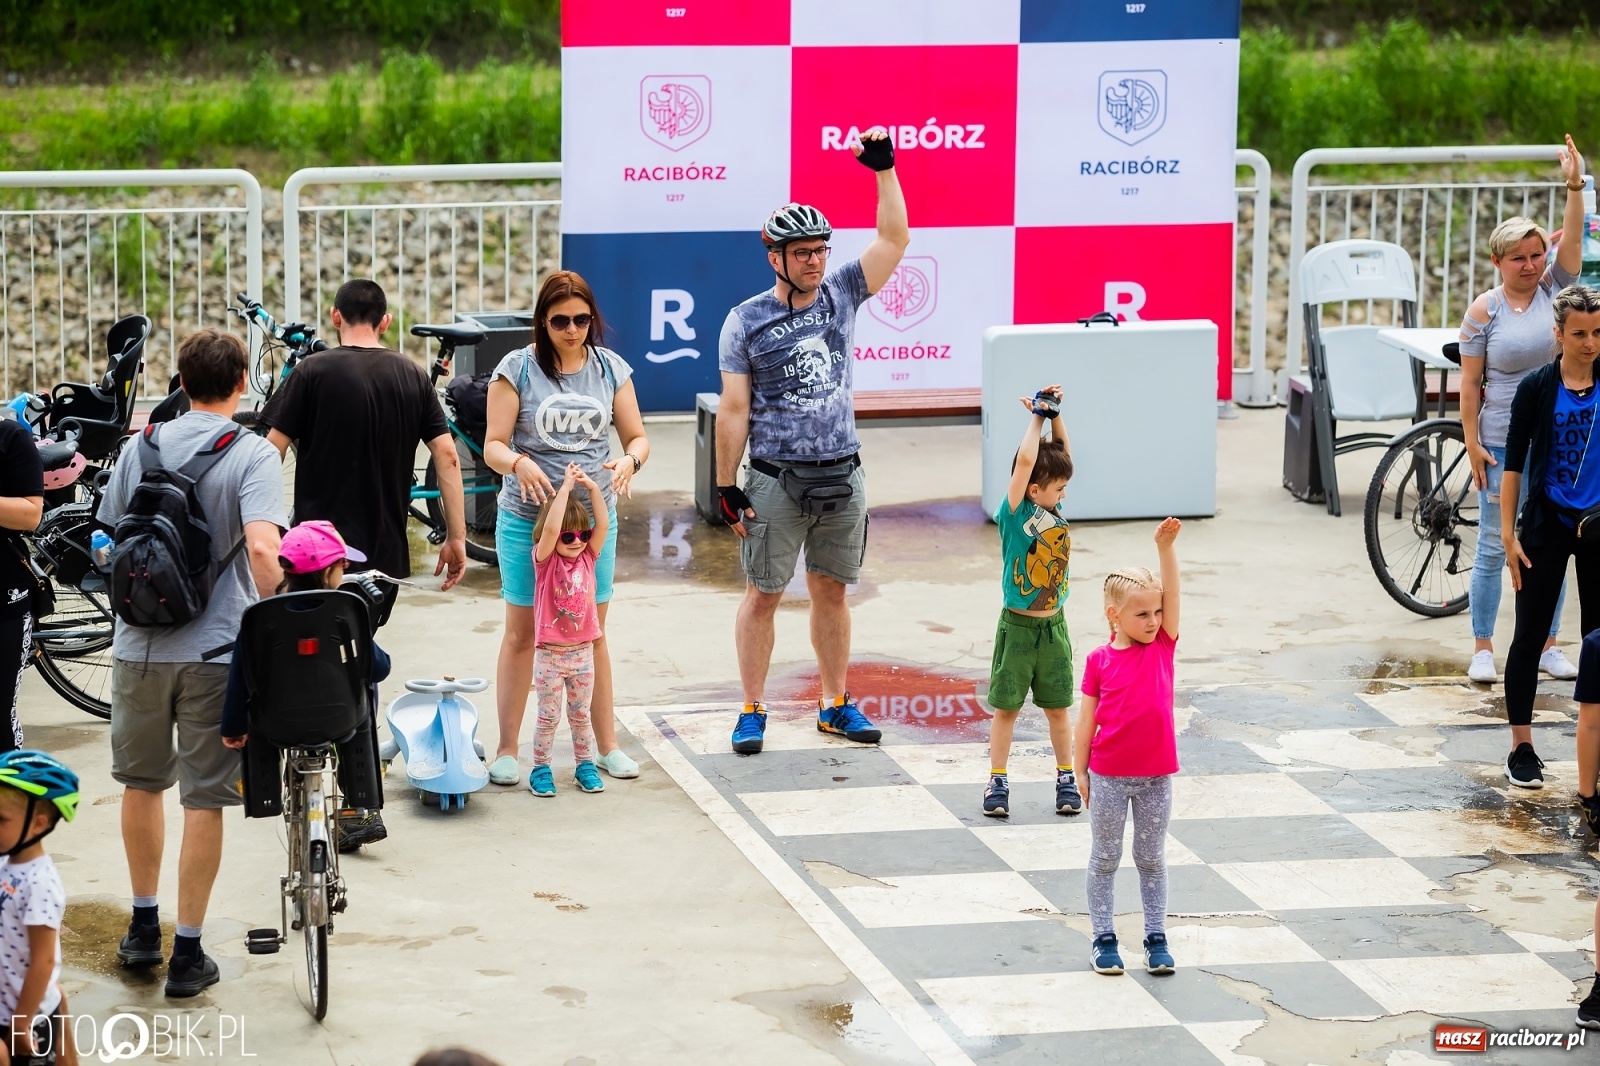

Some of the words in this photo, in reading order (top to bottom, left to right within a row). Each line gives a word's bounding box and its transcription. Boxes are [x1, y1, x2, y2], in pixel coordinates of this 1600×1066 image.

[666, 8, 686, 18] 1217
[1126, 3, 1146, 13] 1217
[822, 117, 986, 151] RAIBÓRZ
[624, 161, 727, 181] RACIBÓRZ
[1080, 155, 1180, 175] RACIBÓRZ
[666, 194, 685, 202] 1217
[1121, 187, 1139, 195] 1217
[650, 288, 697, 341] R
[770, 312, 834, 340] DIESEL
[830, 350, 844, 364] 78
[853, 341, 951, 360] RACIBÓRZ
[782, 364, 796, 378] 19
[891, 373, 910, 381] 1217
[545, 407, 600, 435] MK
[1556, 448, 1586, 465] FO
